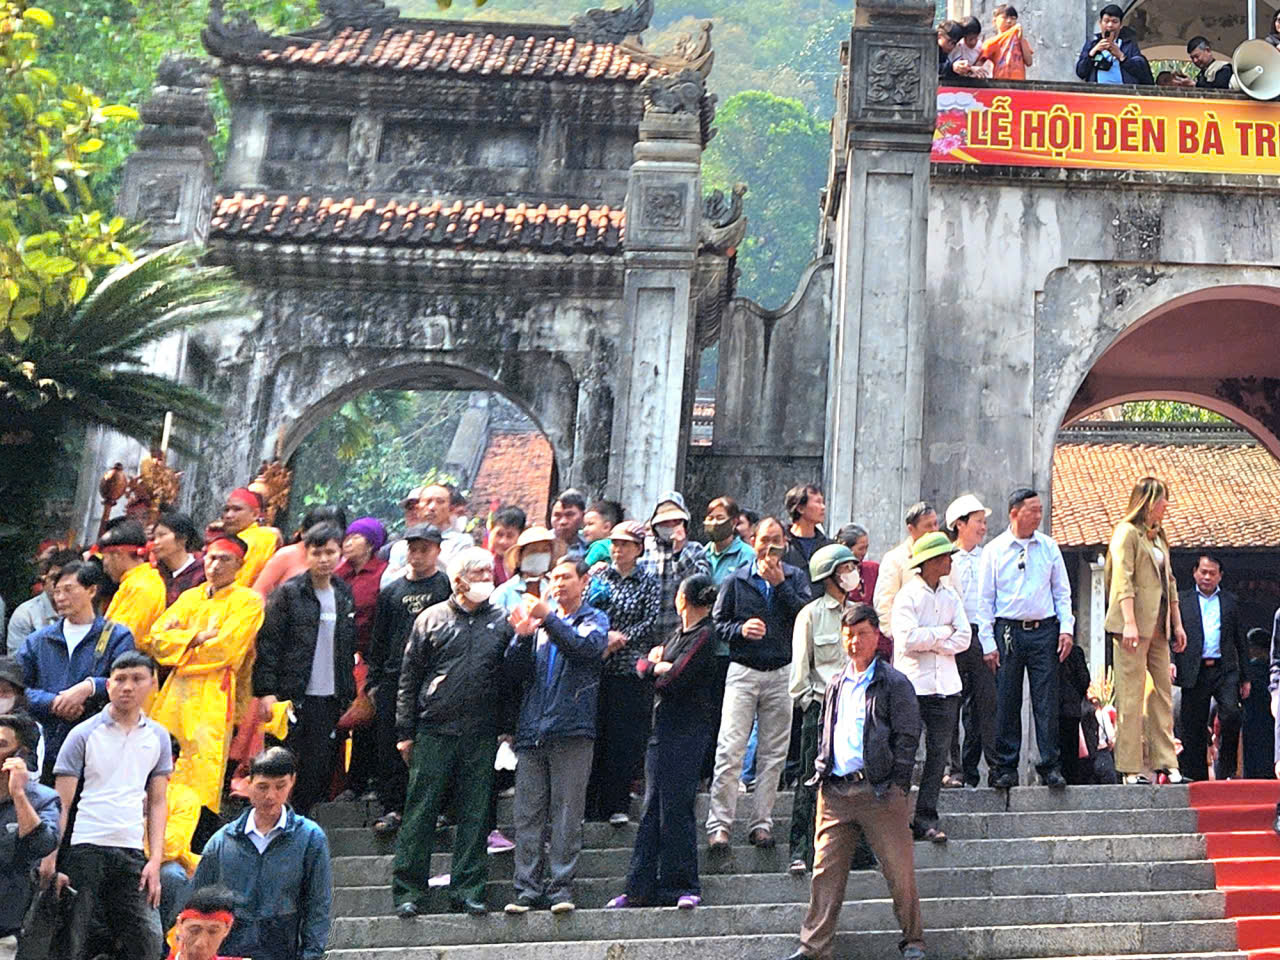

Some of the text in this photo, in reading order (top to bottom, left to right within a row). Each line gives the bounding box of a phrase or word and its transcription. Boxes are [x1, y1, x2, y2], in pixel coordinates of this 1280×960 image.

[969, 97, 1012, 147] LỄ
[1021, 105, 1084, 159] HỘI
[1094, 104, 1166, 154] ĐỀN
[1177, 112, 1226, 156] BÀ
